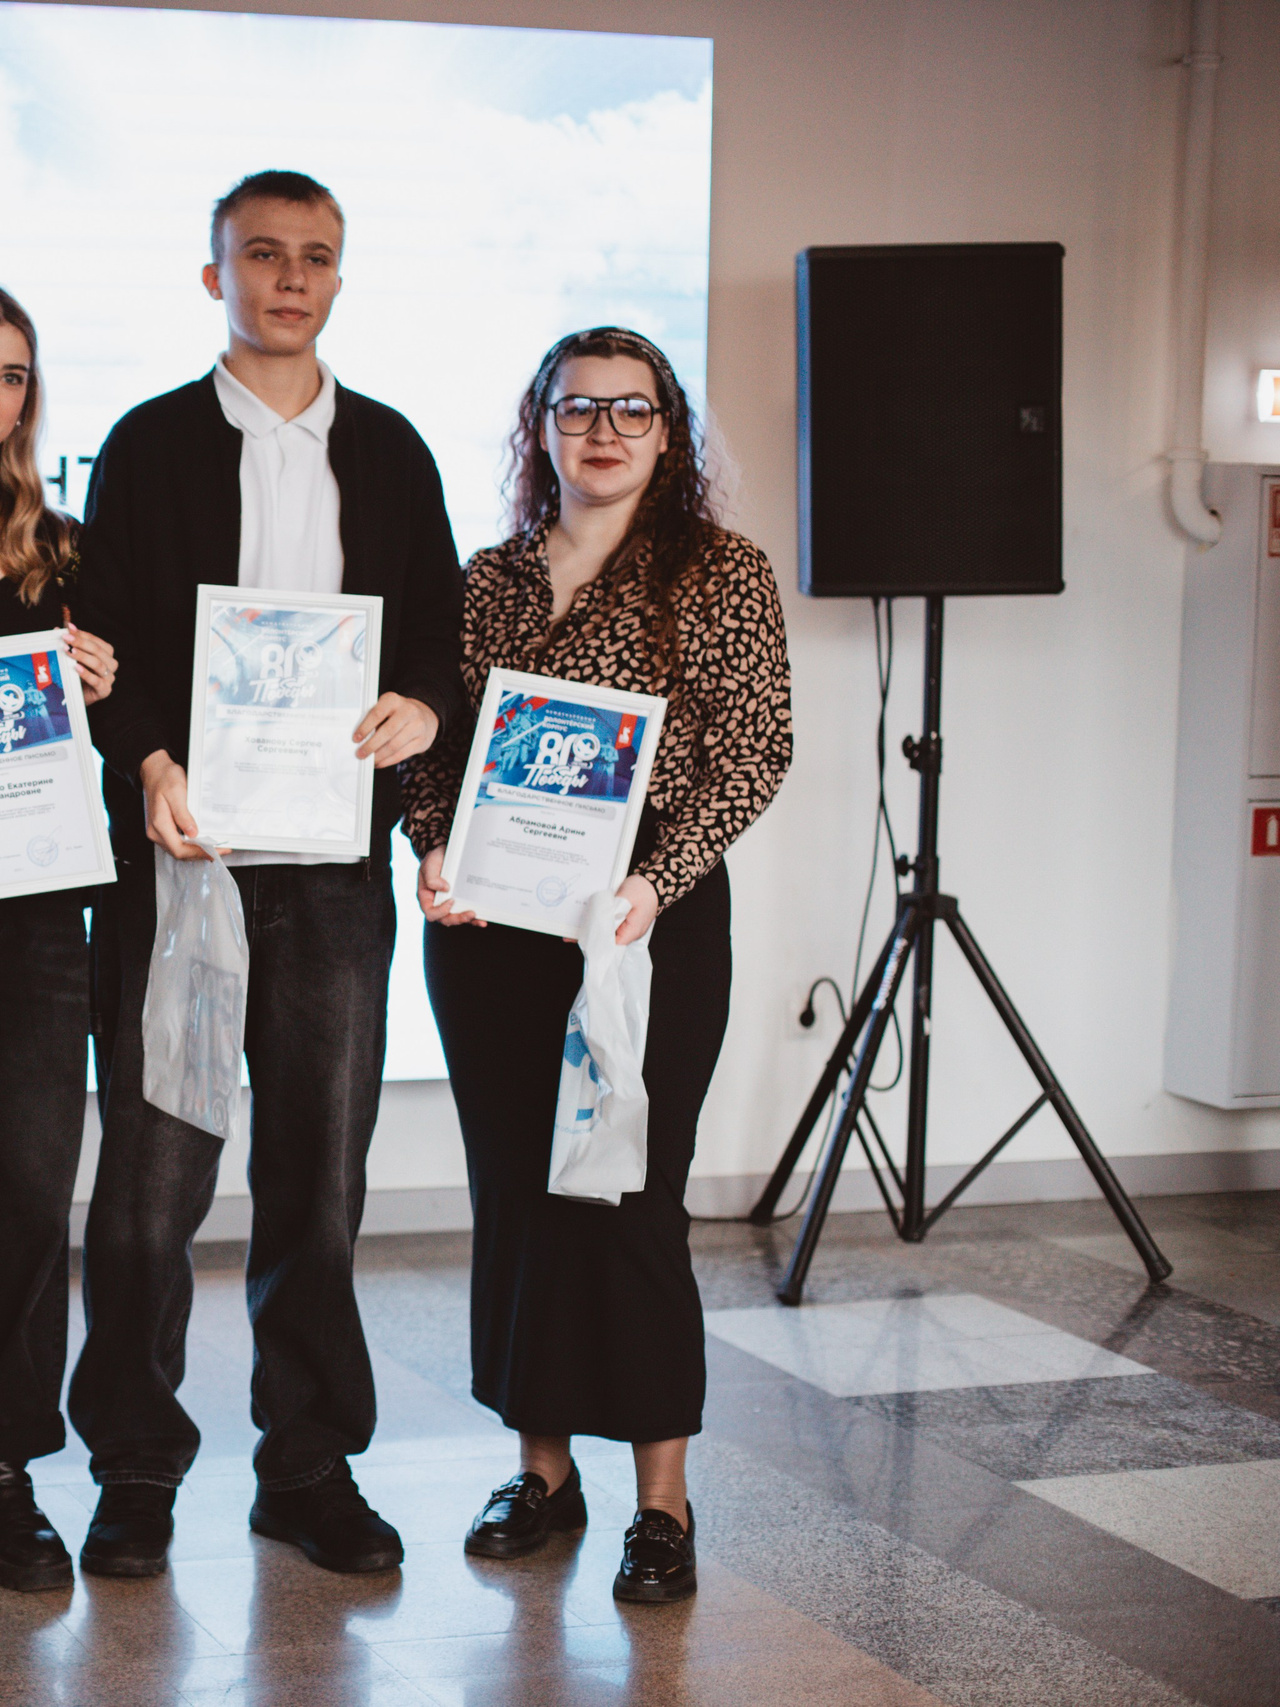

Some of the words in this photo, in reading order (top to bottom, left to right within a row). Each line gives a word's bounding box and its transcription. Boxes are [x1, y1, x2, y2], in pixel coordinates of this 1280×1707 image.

[7, 777, 54, 790] Екатерине
[509, 815, 557, 831] Абрамовой
[559, 825, 587, 837] Арине
[523, 826, 568, 842] Сергеевне
